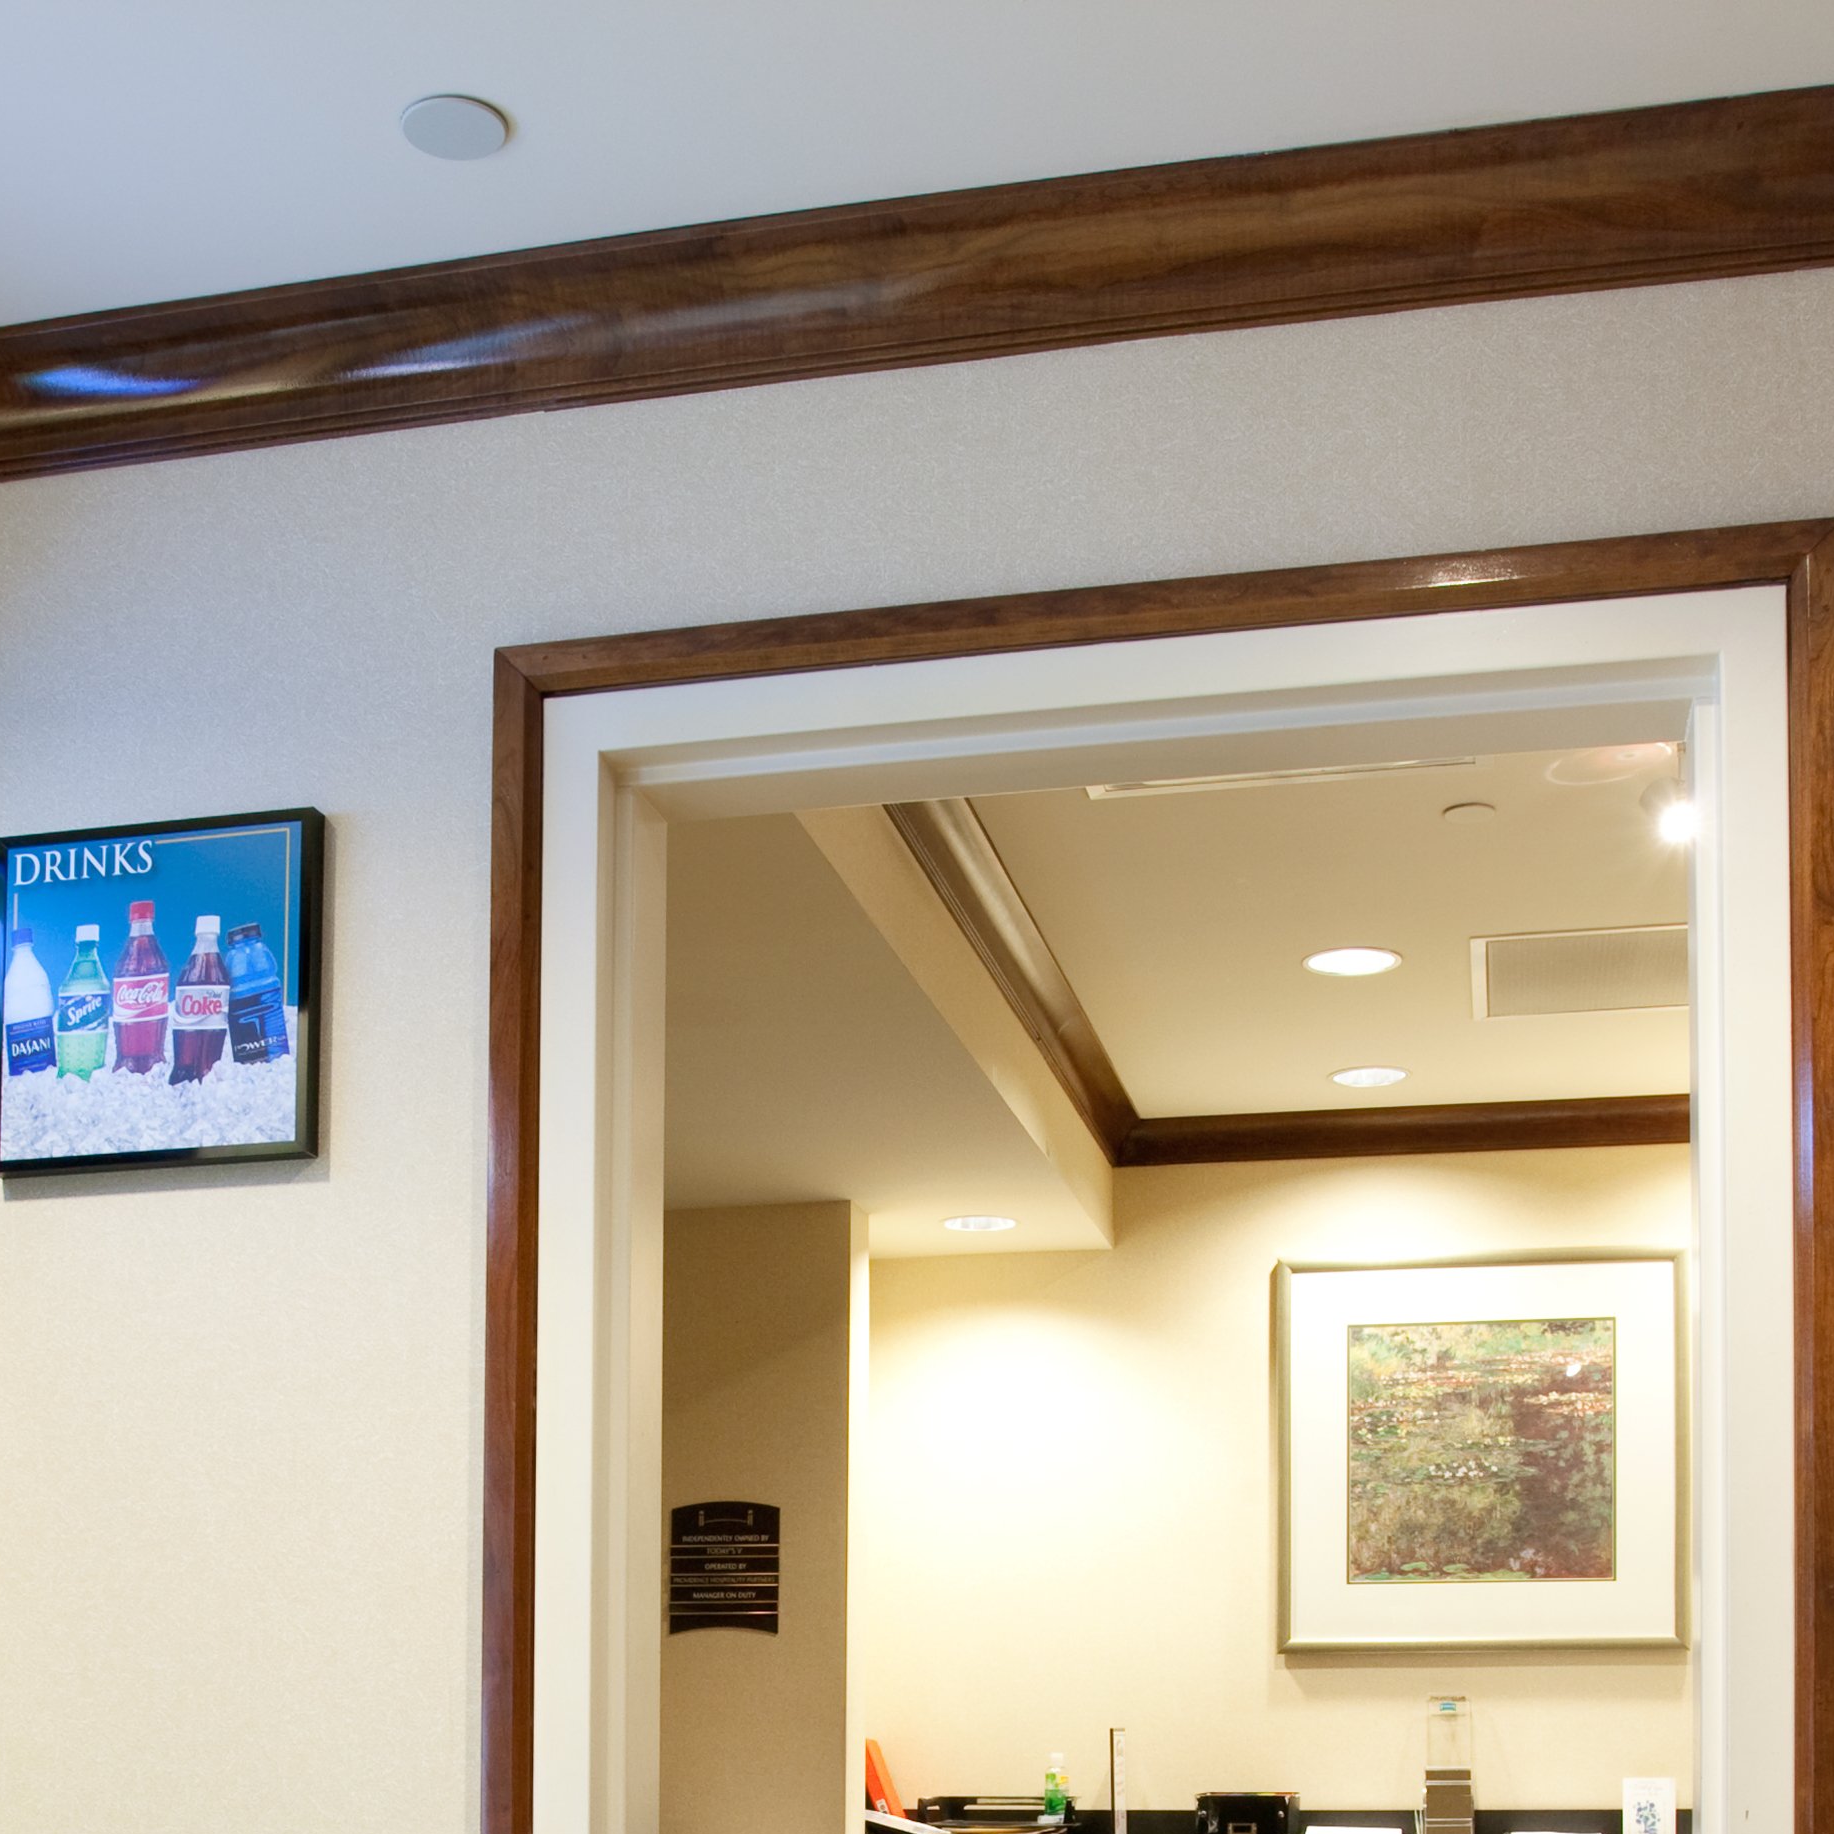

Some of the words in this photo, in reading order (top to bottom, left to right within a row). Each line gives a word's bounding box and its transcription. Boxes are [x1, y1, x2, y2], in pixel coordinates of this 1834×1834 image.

[13, 840, 155, 887] DRINKS
[67, 993, 102, 1026] Sprite
[181, 994, 222, 1016] Coke
[11, 1036, 51, 1057] DASANI
